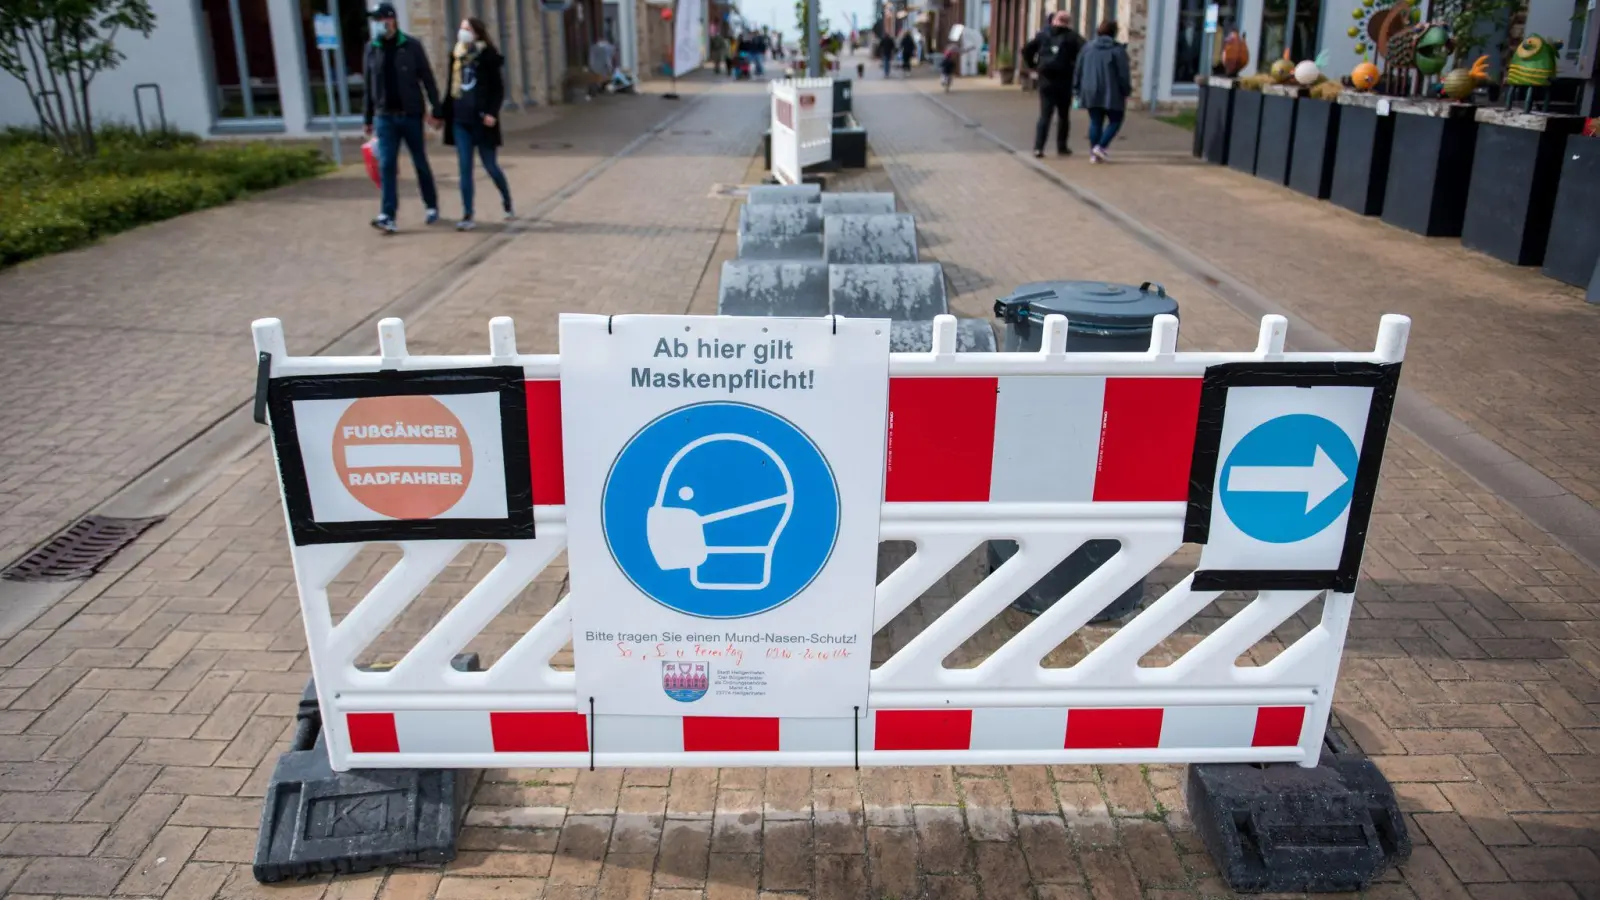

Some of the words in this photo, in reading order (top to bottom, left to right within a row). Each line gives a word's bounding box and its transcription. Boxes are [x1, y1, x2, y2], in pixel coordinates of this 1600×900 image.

[653, 337, 689, 358] Ab
[697, 338, 746, 359] hier
[753, 339, 794, 365] gilt
[631, 367, 815, 394] Maskenpflicht!
[348, 471, 463, 486] RADFAHRER
[585, 630, 614, 642] Bitte
[618, 631, 658, 644] tragen
[662, 631, 682, 643] Sie
[686, 632, 721, 643] einen
[725, 631, 858, 645] Mund-Nasen-Schutz!
